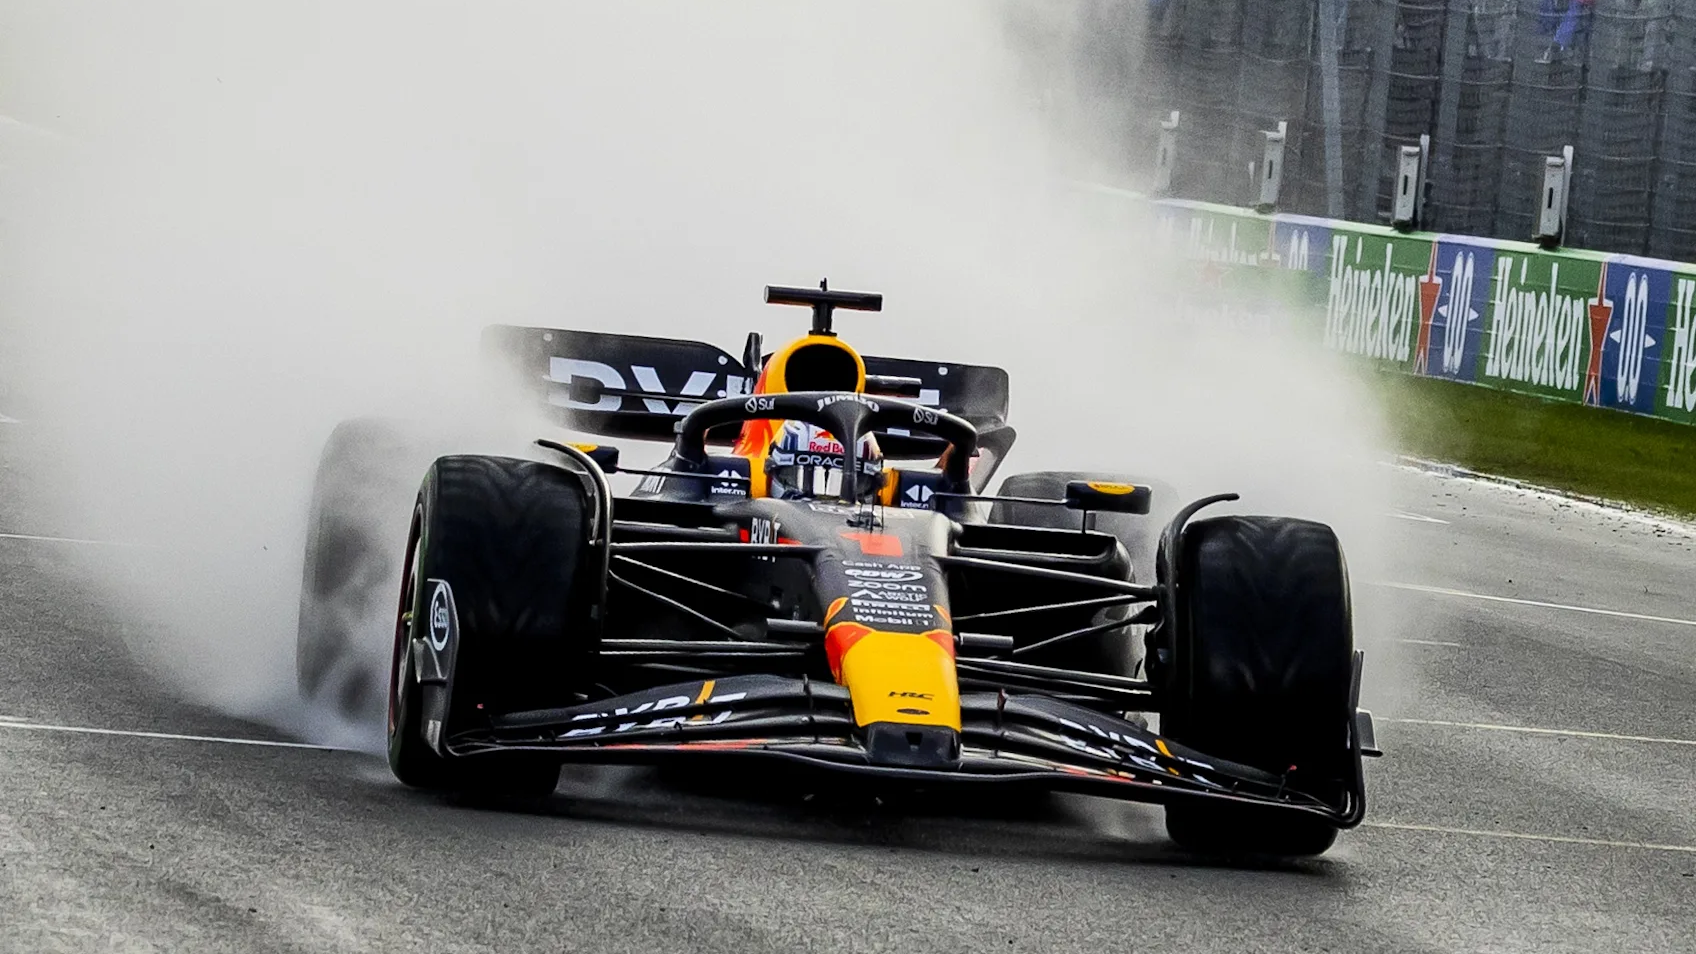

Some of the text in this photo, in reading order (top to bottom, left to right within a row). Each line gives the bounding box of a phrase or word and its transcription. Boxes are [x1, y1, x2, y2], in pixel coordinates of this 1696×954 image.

[1325, 235, 1416, 362] Heineken
[1485, 257, 1585, 390] Heineken
[817, 394, 879, 413] JUMBO
[809, 442, 831, 452] Red
[796, 454, 862, 471] ORACE
[842, 560, 883, 568] Cash
[848, 580, 927, 592] zoom
[855, 615, 913, 625] Mobil
